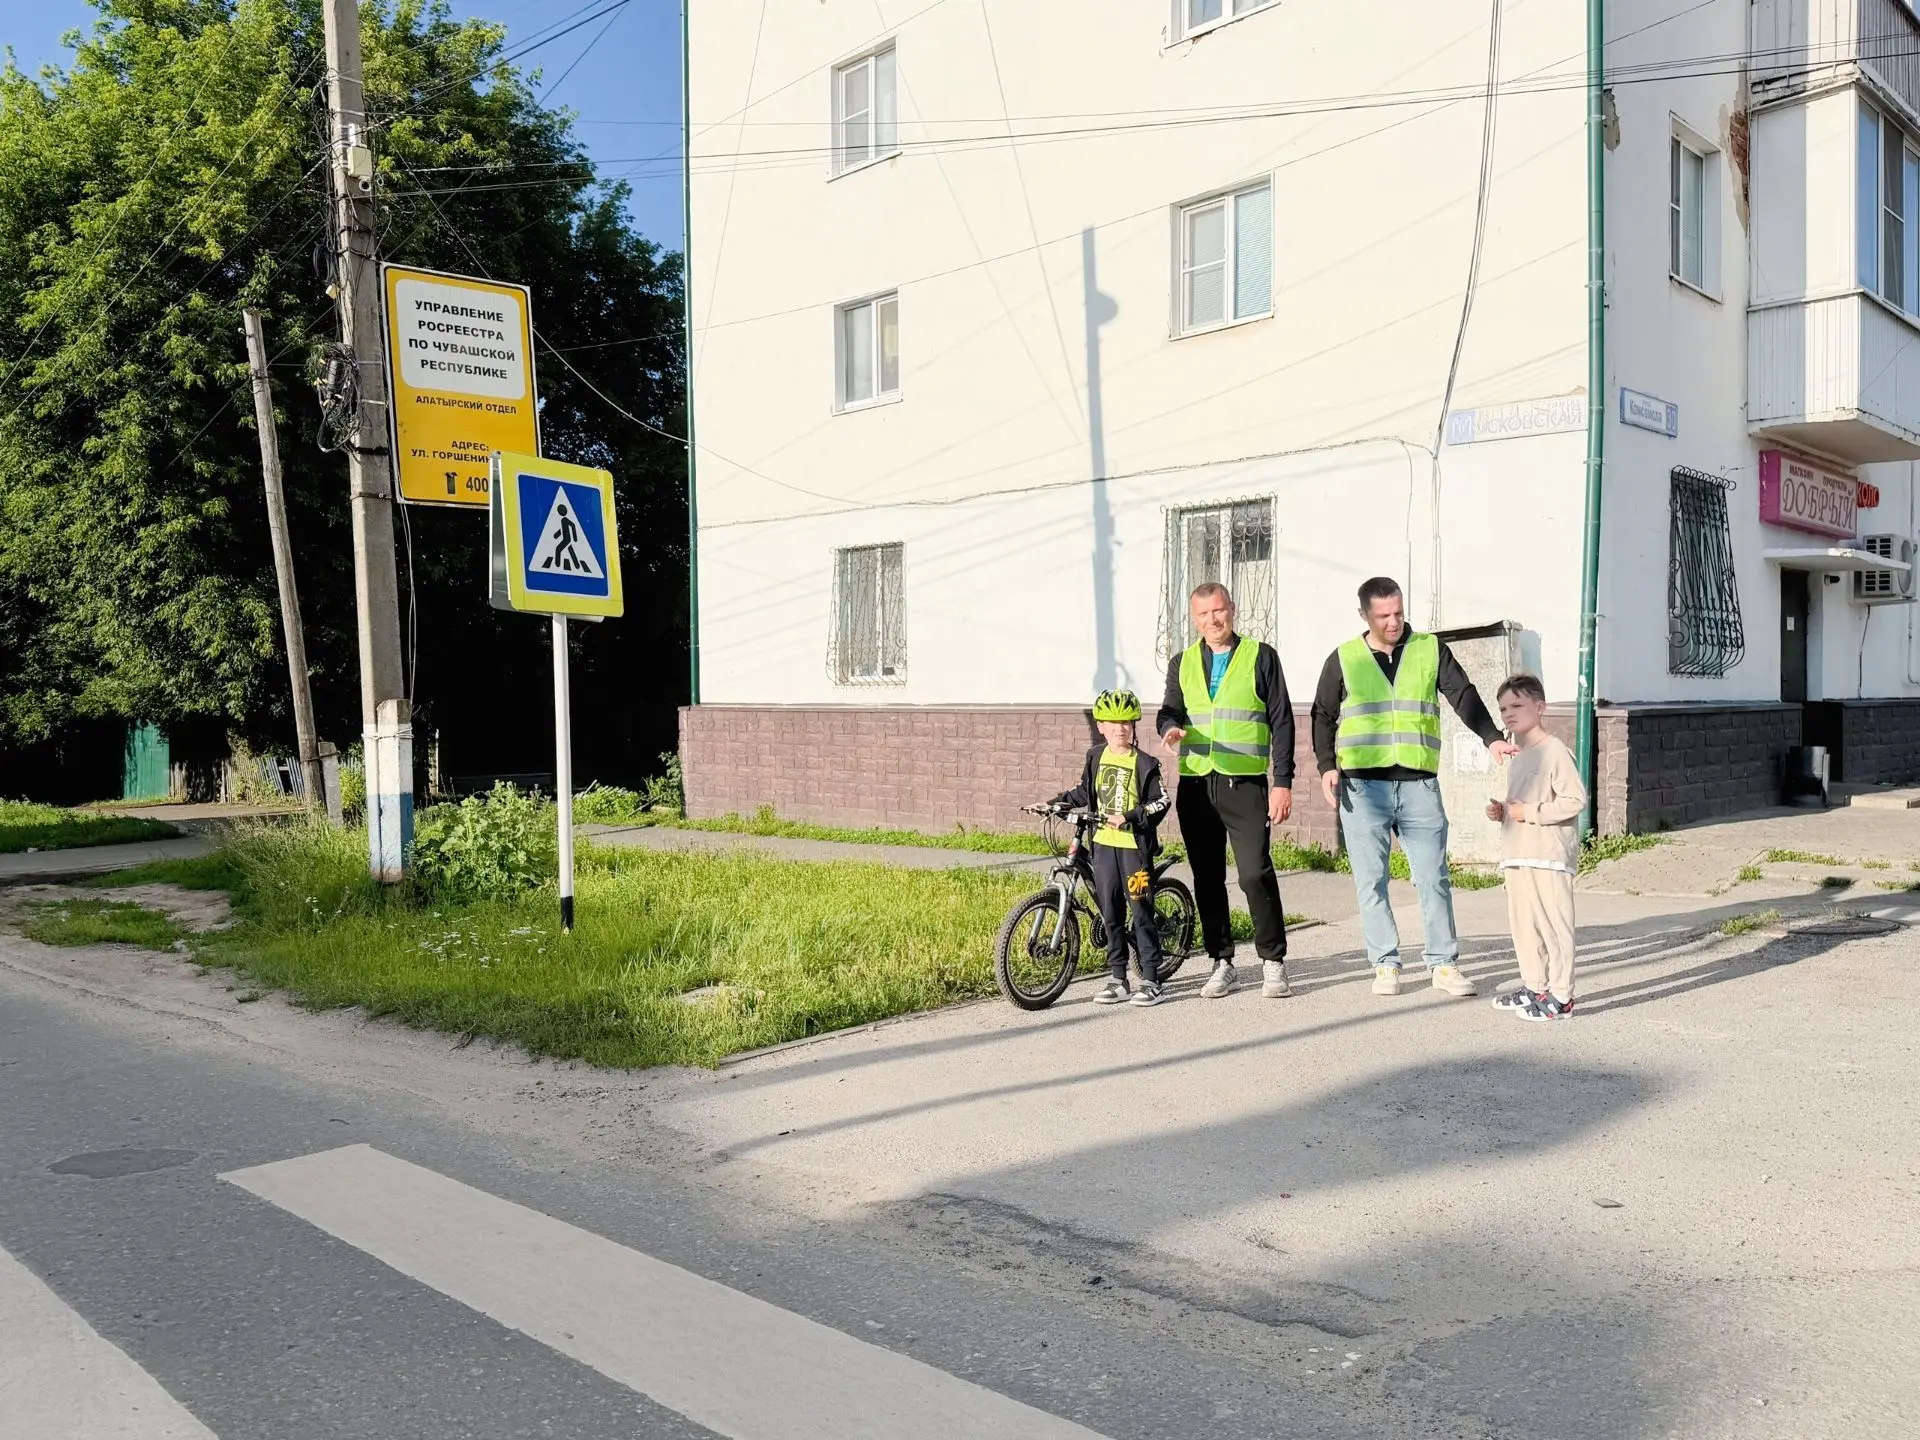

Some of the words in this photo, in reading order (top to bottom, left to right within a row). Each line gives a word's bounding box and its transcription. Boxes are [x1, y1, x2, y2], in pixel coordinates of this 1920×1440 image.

[415, 300, 503, 322] УПРАВЛЕНИЕ
[418, 320, 504, 341] РОСРЕЕСТРА
[409, 338, 427, 350] ПО
[433, 342, 515, 361] ЧУВАШСКОЙ
[421, 359, 507, 379] РЕСПУБЛИКЕ
[416, 395, 483, 411] АЛАТЫРСКИЙ
[485, 403, 517, 415] ОТДЕЛ
[411, 449, 430, 458] УЛ.
[451, 440, 490, 452] АДРЕС:
[1782, 478, 1855, 530] ДОБРЫЙ
